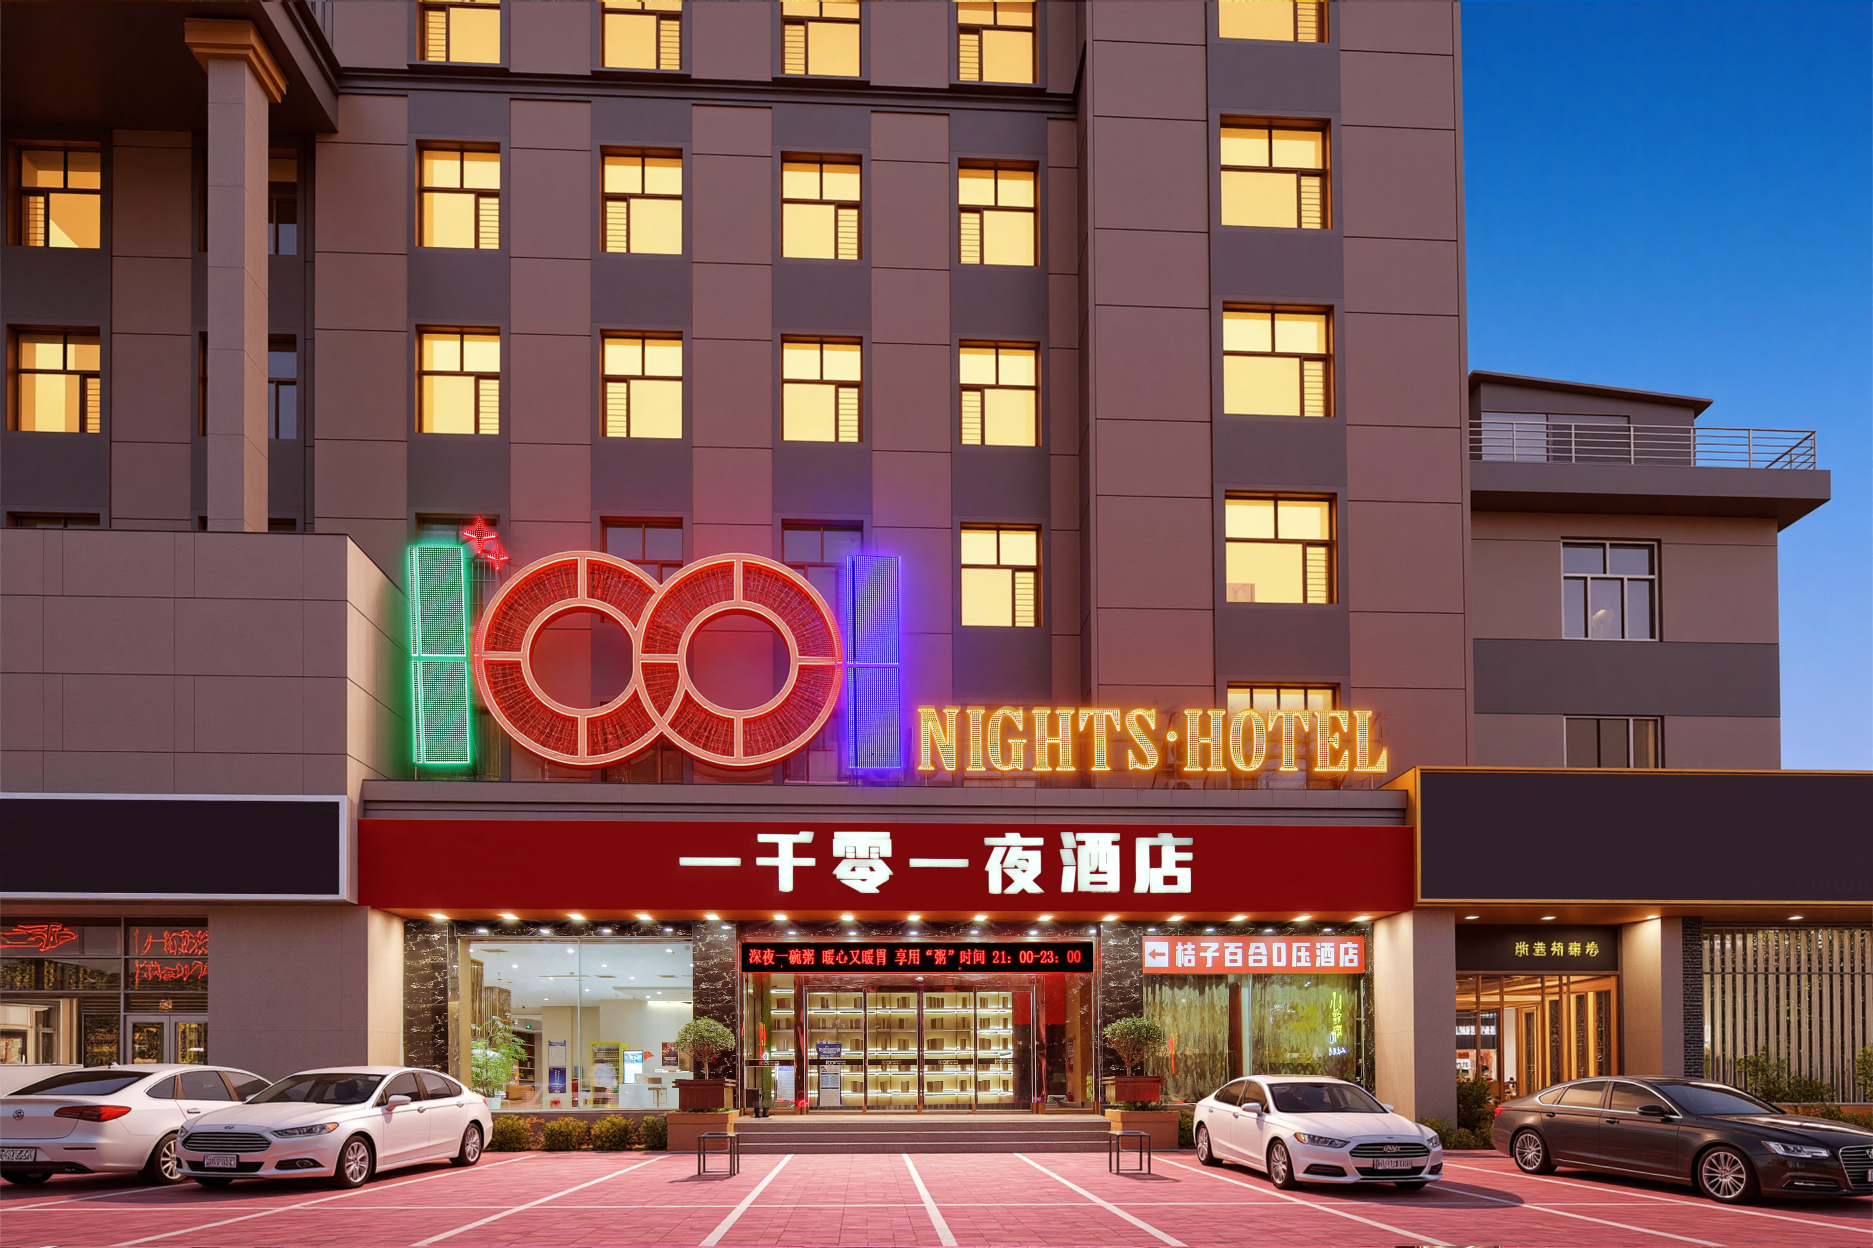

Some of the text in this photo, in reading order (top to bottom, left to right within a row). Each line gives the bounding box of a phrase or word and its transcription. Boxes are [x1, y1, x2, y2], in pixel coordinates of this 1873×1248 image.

[679, 831, 1194, 894] 一千零一夜酒店
[748, 948, 815, 966] 深夜一碗粥
[822, 948, 887, 966] 暖心又暖胃
